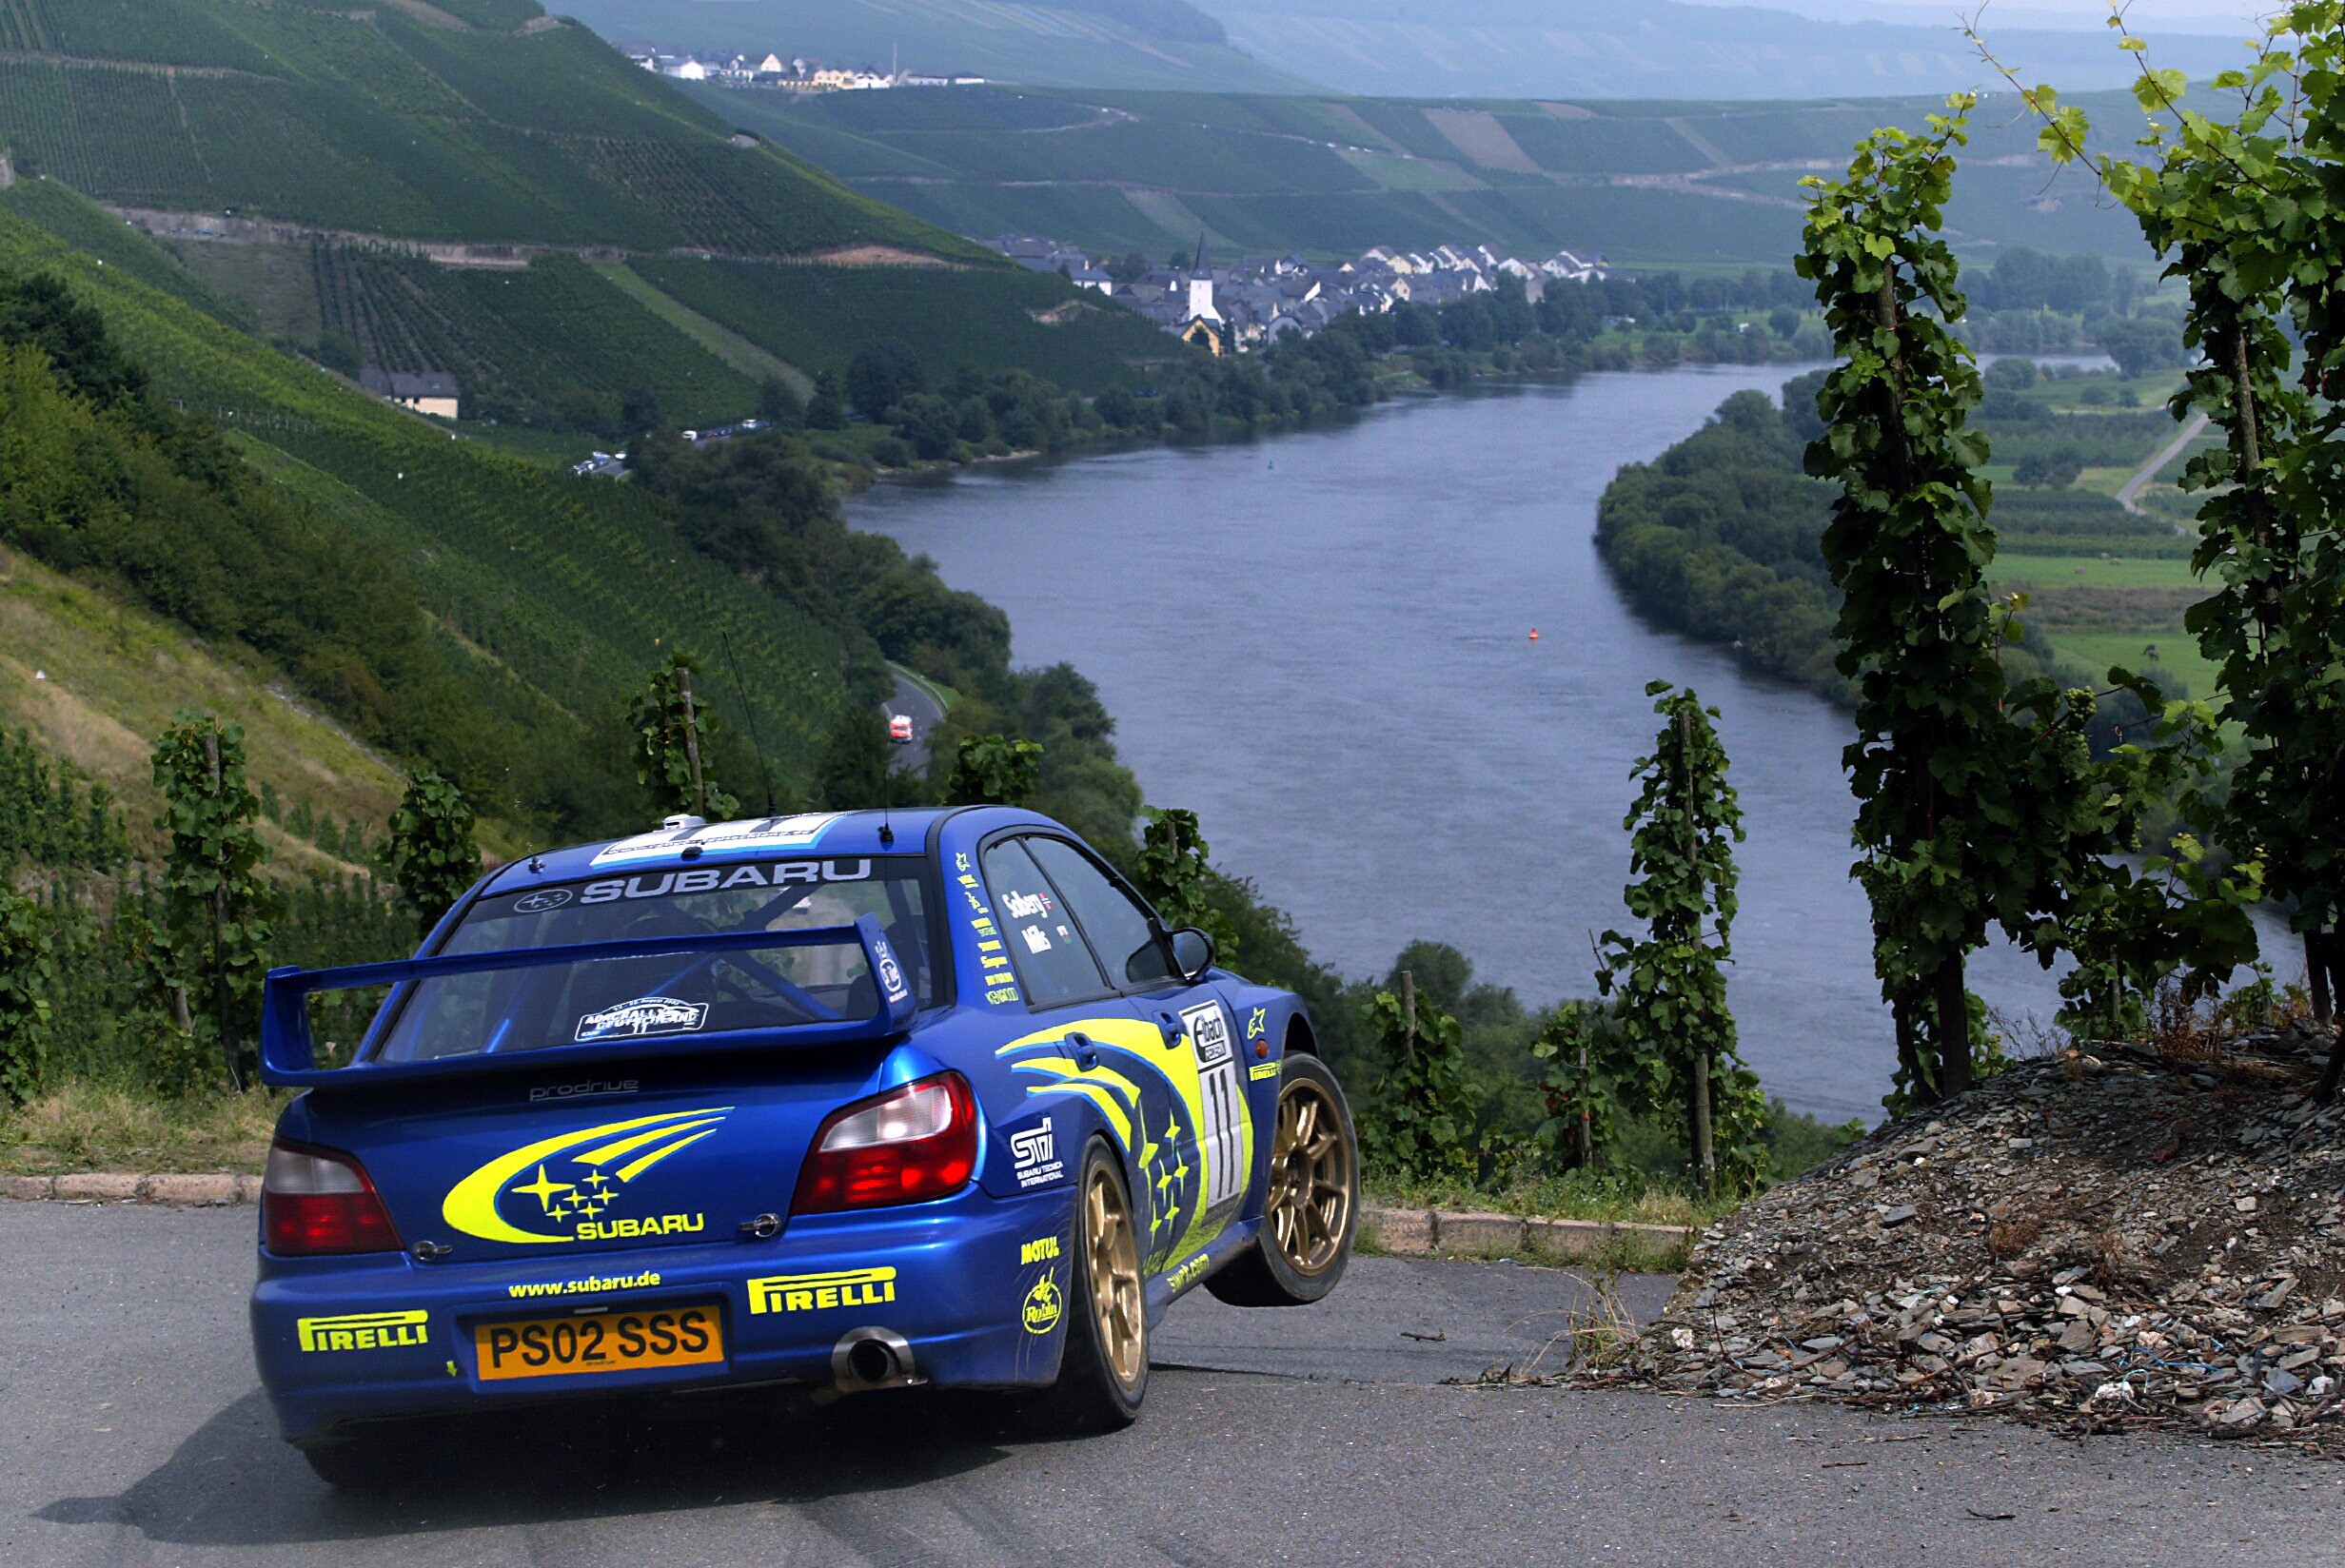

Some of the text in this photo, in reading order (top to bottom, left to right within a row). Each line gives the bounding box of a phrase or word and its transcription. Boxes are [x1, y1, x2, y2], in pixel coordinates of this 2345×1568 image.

[580, 858, 872, 904] SUBARU
[529, 1079, 640, 1102] prodrive
[1209, 1068, 1234, 1199] 11
[577, 1213, 704, 1240] SUBARU
[1021, 1236, 1059, 1265] MOTUL
[509, 1270, 660, 1298] www.subaru.de
[747, 1266, 897, 1314] PIRELLI
[297, 1309, 428, 1352] PIRELLI
[490, 1311, 709, 1368] PS02 SSS
